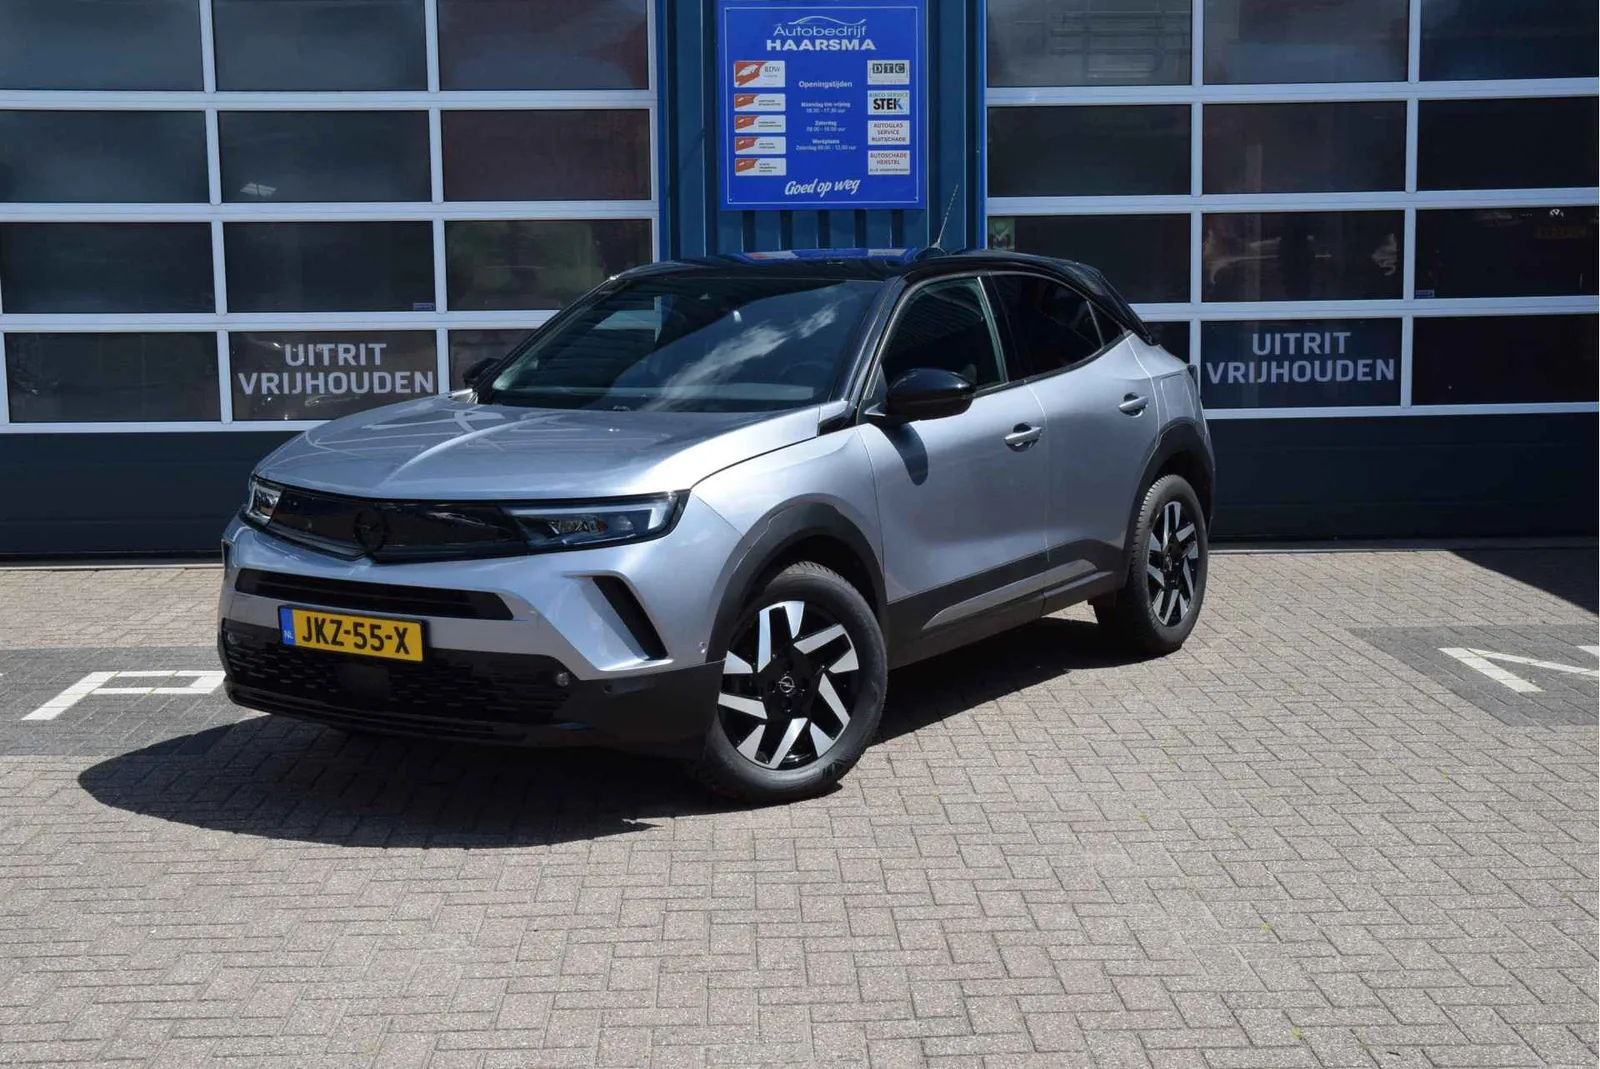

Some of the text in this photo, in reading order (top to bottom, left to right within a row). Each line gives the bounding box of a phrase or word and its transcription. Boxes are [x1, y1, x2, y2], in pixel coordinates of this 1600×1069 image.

[773, 25, 867, 38] Autobedrijf
[766, 39, 876, 51] HAARSMA
[873, 63, 905, 73] DTC
[798, 80, 853, 88] Openingstijden
[873, 98, 904, 110] STEK
[784, 178, 860, 197] Goed op weg
[1252, 331, 1351, 356] UITRIT
[285, 343, 387, 367] UITRIT
[1207, 358, 1395, 385] VRIJHOUDEN
[238, 371, 435, 395] VRIJHOUDEN
[283, 615, 411, 656] NL JKZ-55-X
